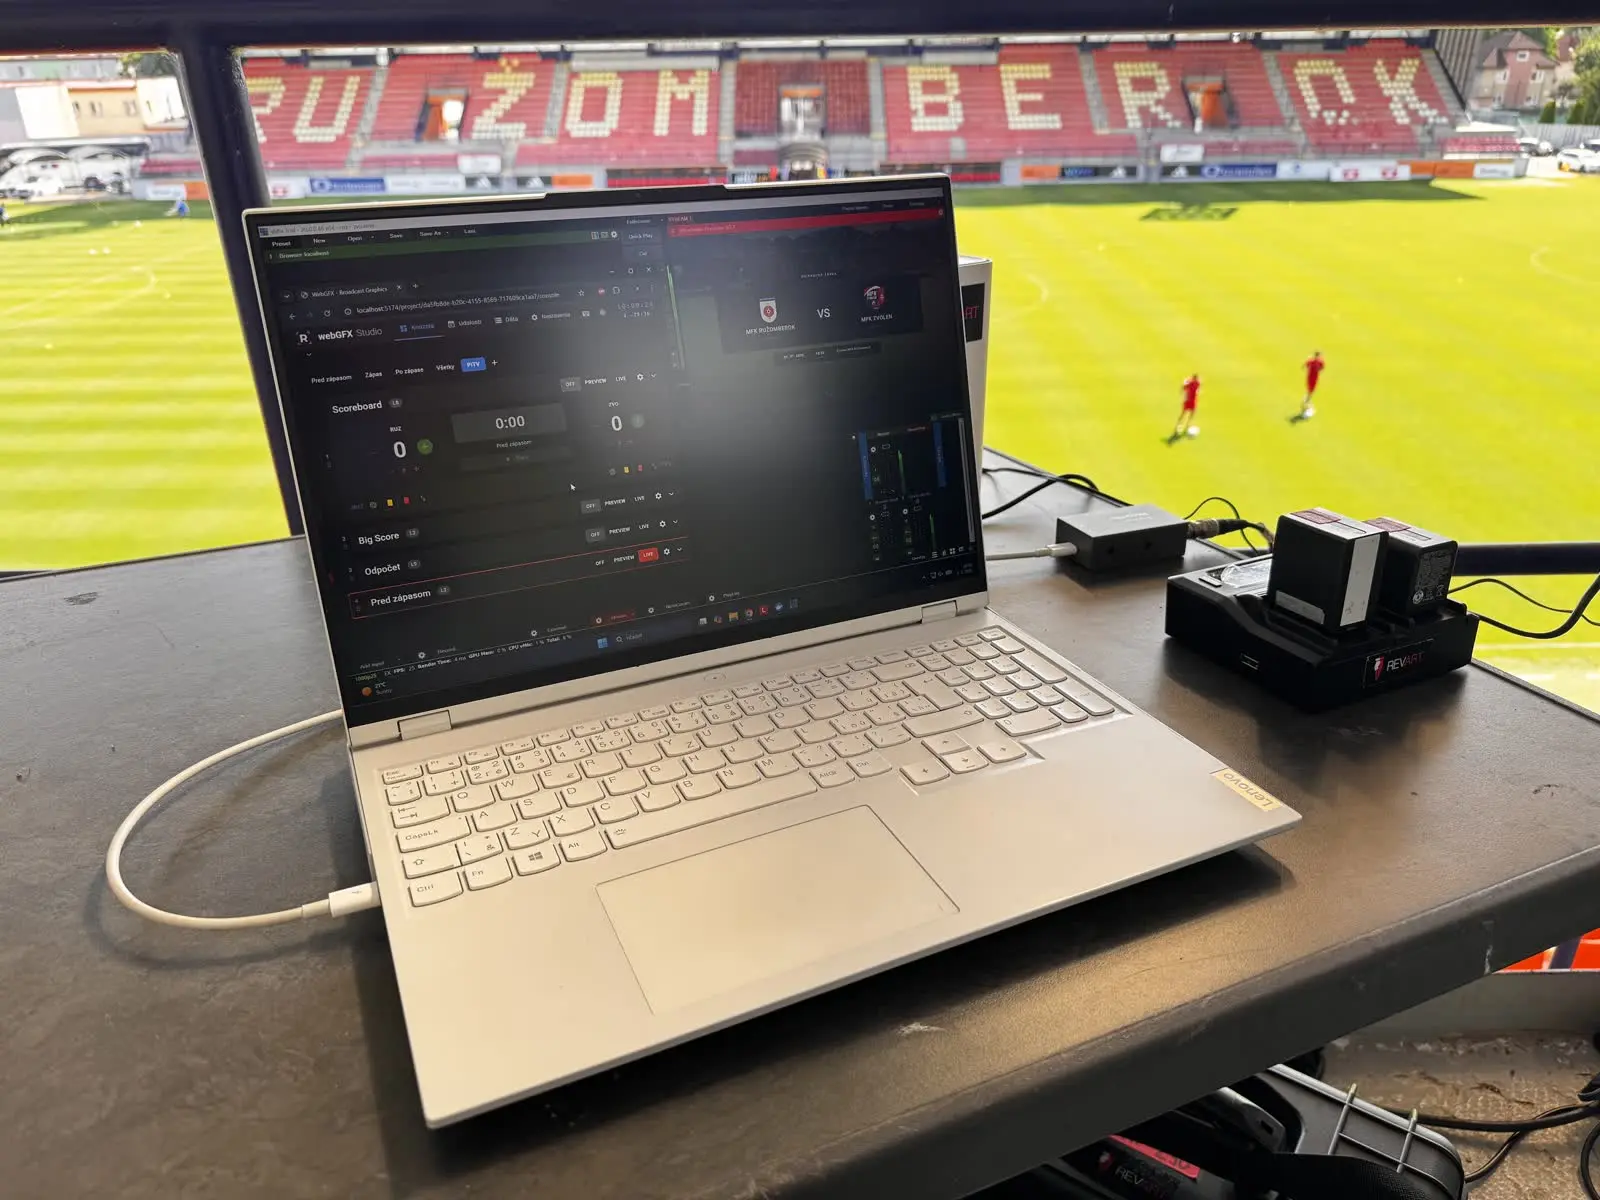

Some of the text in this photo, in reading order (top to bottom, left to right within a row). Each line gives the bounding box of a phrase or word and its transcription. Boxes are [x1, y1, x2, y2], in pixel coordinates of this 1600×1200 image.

[339, 288, 365, 296] Broadcast
[365, 287, 388, 295] Graphics
[816, 307, 832, 318] VS
[318, 327, 383, 341] webGFX Studio
[404, 367, 424, 375] zápase
[435, 363, 455, 371] Všetky
[326, 374, 352, 383] zápasom
[364, 371, 383, 379] Zápas
[331, 400, 383, 414] Scoreboard
[495, 415, 526, 429] 0:00
[611, 415, 623, 431] 0
[393, 441, 407, 458] 0
[604, 498, 626, 506] PREVIEW
[358, 532, 400, 546] Big Score
[613, 554, 635, 563] PREVIEW
[364, 563, 401, 576] Odpočet
[370, 589, 431, 606] Pred zápasom
[417, 661, 436, 669] Render
[1386, 651, 1425, 672] REVART
[762, 759, 774, 767] M
[502, 780, 514, 788] W
[1223, 773, 1274, 807] Lenovo
[457, 791, 469, 799] Q
[405, 829, 439, 841] CapsLk
[568, 841, 579, 849] Alt
[416, 884, 434, 893] Ctrl
